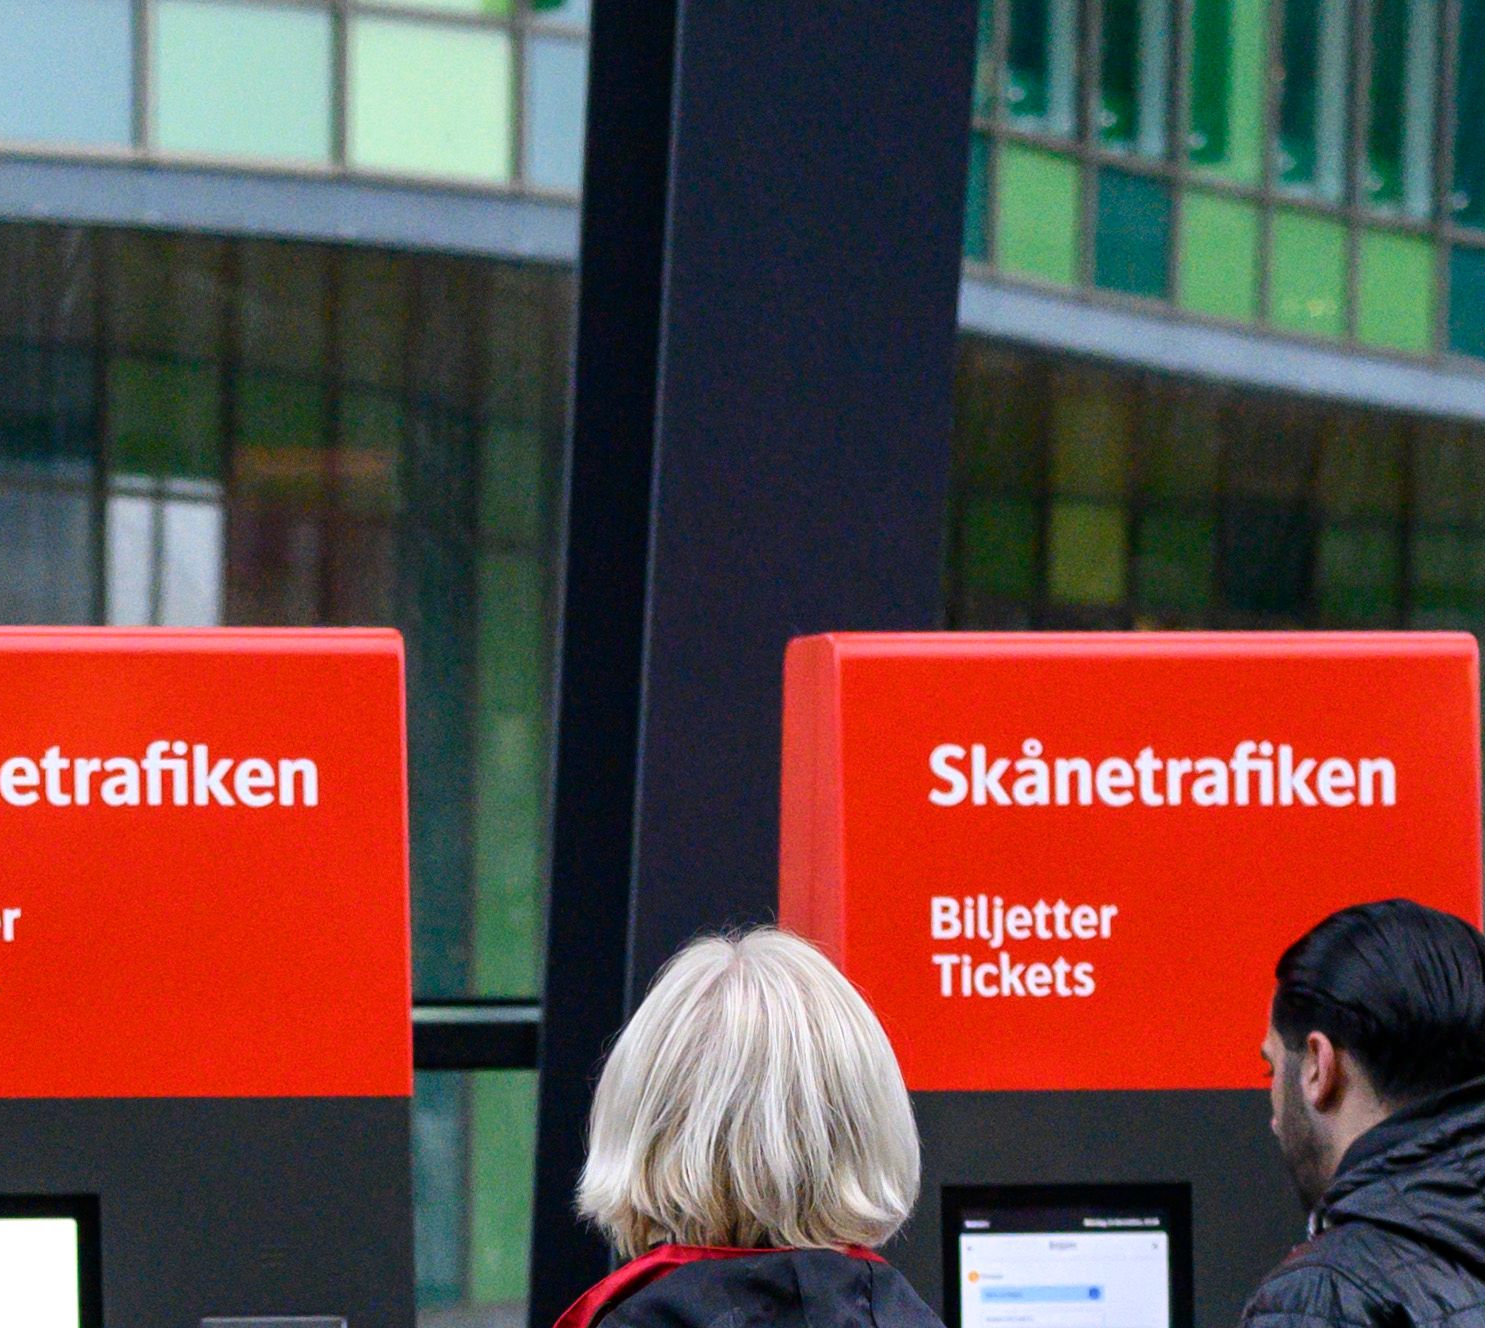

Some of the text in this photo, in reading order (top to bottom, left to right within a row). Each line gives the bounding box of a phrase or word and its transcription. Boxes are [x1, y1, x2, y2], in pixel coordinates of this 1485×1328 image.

[928, 738, 1397, 808] Skånetrafiken
[931, 894, 1119, 949] Biljetter
[931, 951, 1096, 998] Tickets
